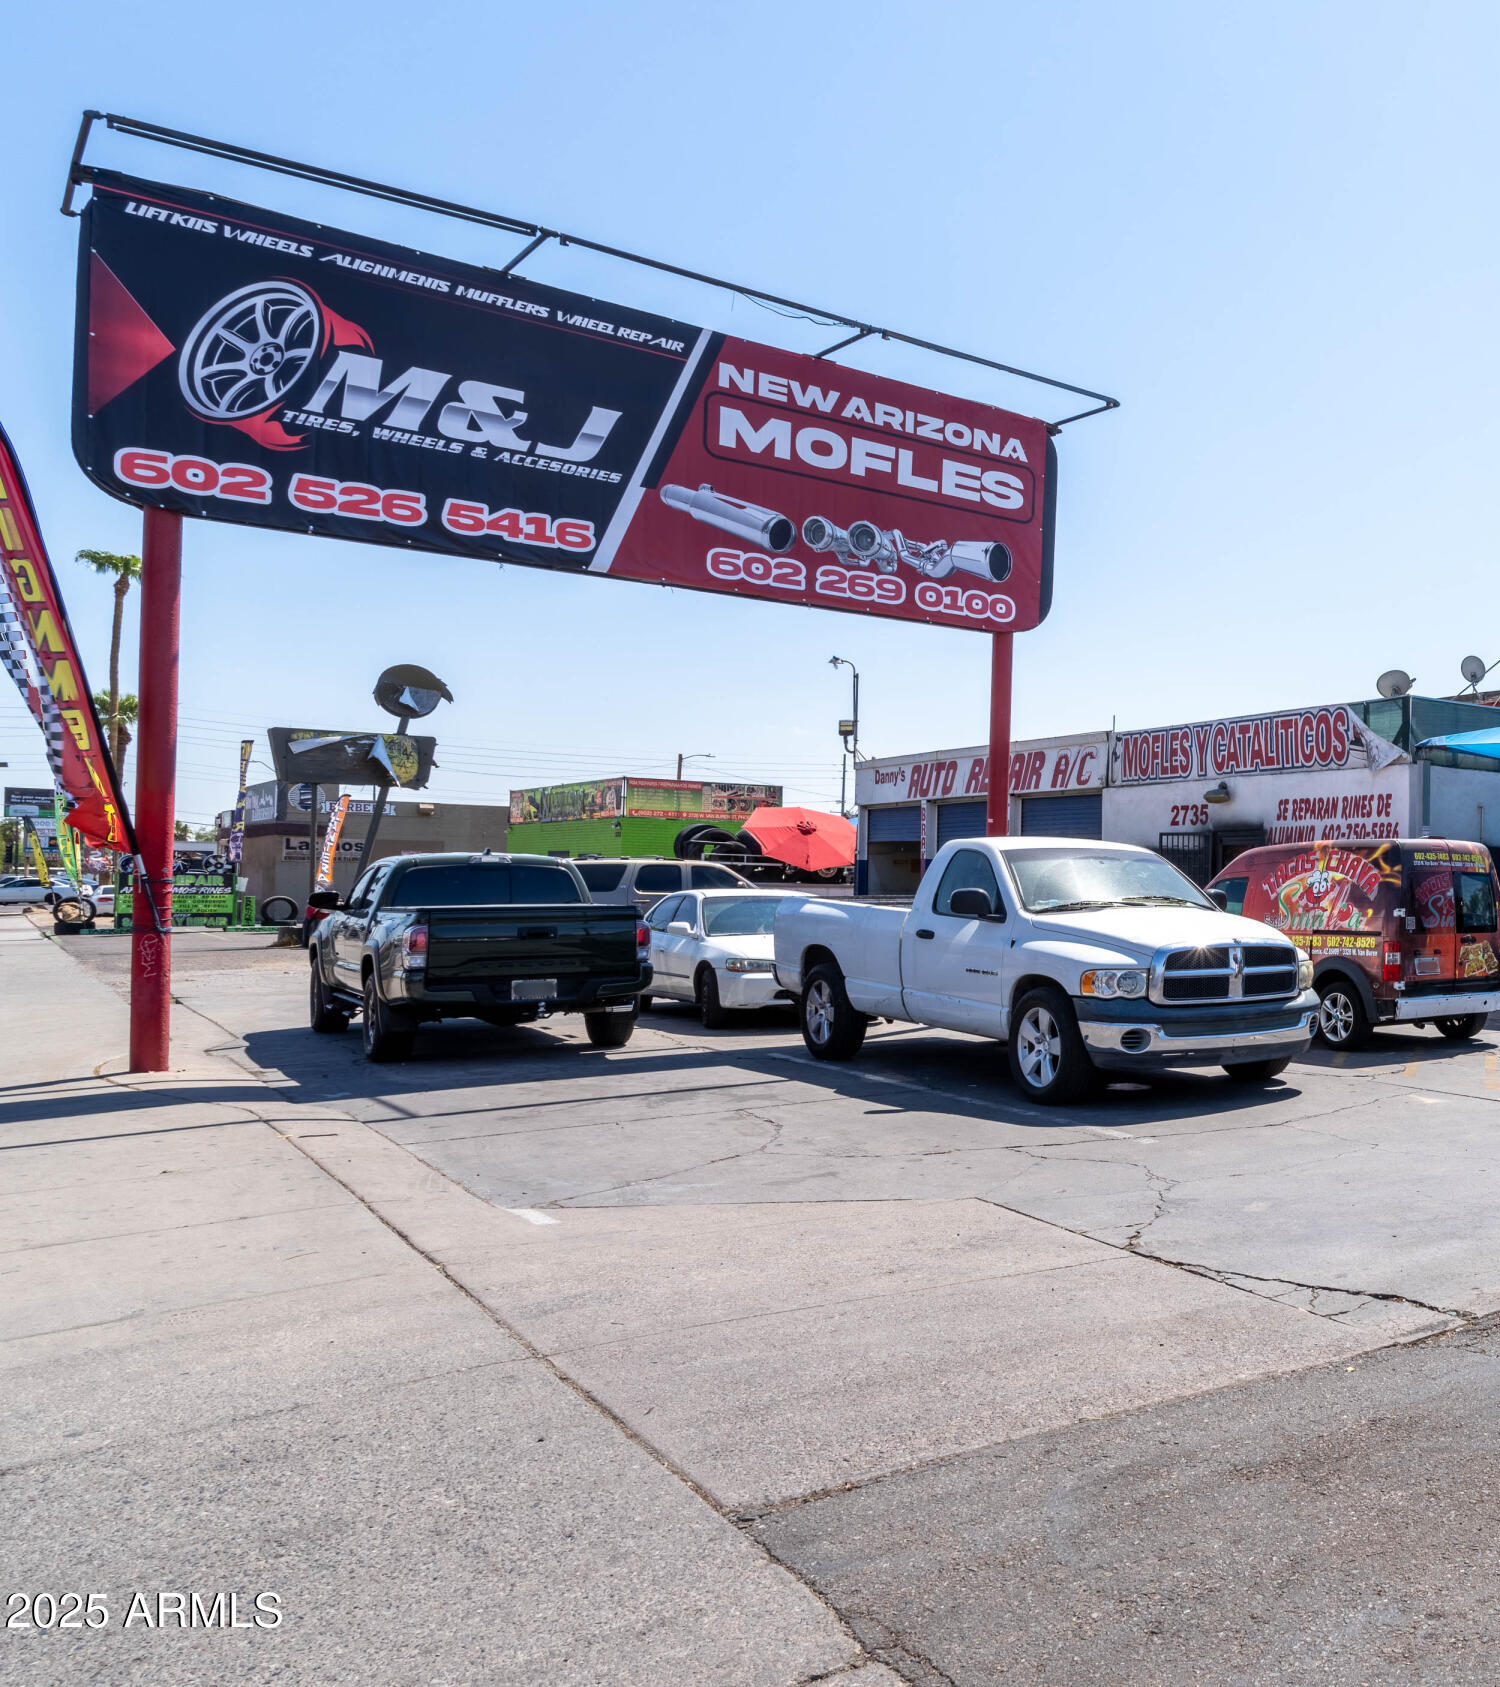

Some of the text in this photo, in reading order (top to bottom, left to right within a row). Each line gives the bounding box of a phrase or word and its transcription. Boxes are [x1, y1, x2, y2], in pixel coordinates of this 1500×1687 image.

[223, 225, 314, 258] WHEELS
[318, 252, 451, 293] ALIGNMENTS
[455, 285, 550, 318] MUFFLERS
[556, 310, 615, 335] WHEEL
[617, 326, 684, 352] REPAIR
[283, 410, 623, 484] TIRES, WHEELS & ACCESORIES
[718, 362, 1028, 463] NEW ARIZONA
[719, 405, 1024, 511] MOFLES
[114, 447, 597, 552] 602 526 5416
[706, 547, 1016, 622] 602 269 0100
[874, 745, 1098, 800] Danny's AUTO REAIR A/C
[1121, 709, 1348, 780] MOFLES Y CATALITICOS
[1170, 804, 1209, 826] 2735
[1277, 793, 1393, 821] SE REPARAN RINES DE
[173, 875, 224, 886] EPAIR
[1263, 850, 1381, 900] TACOS CHAVA
